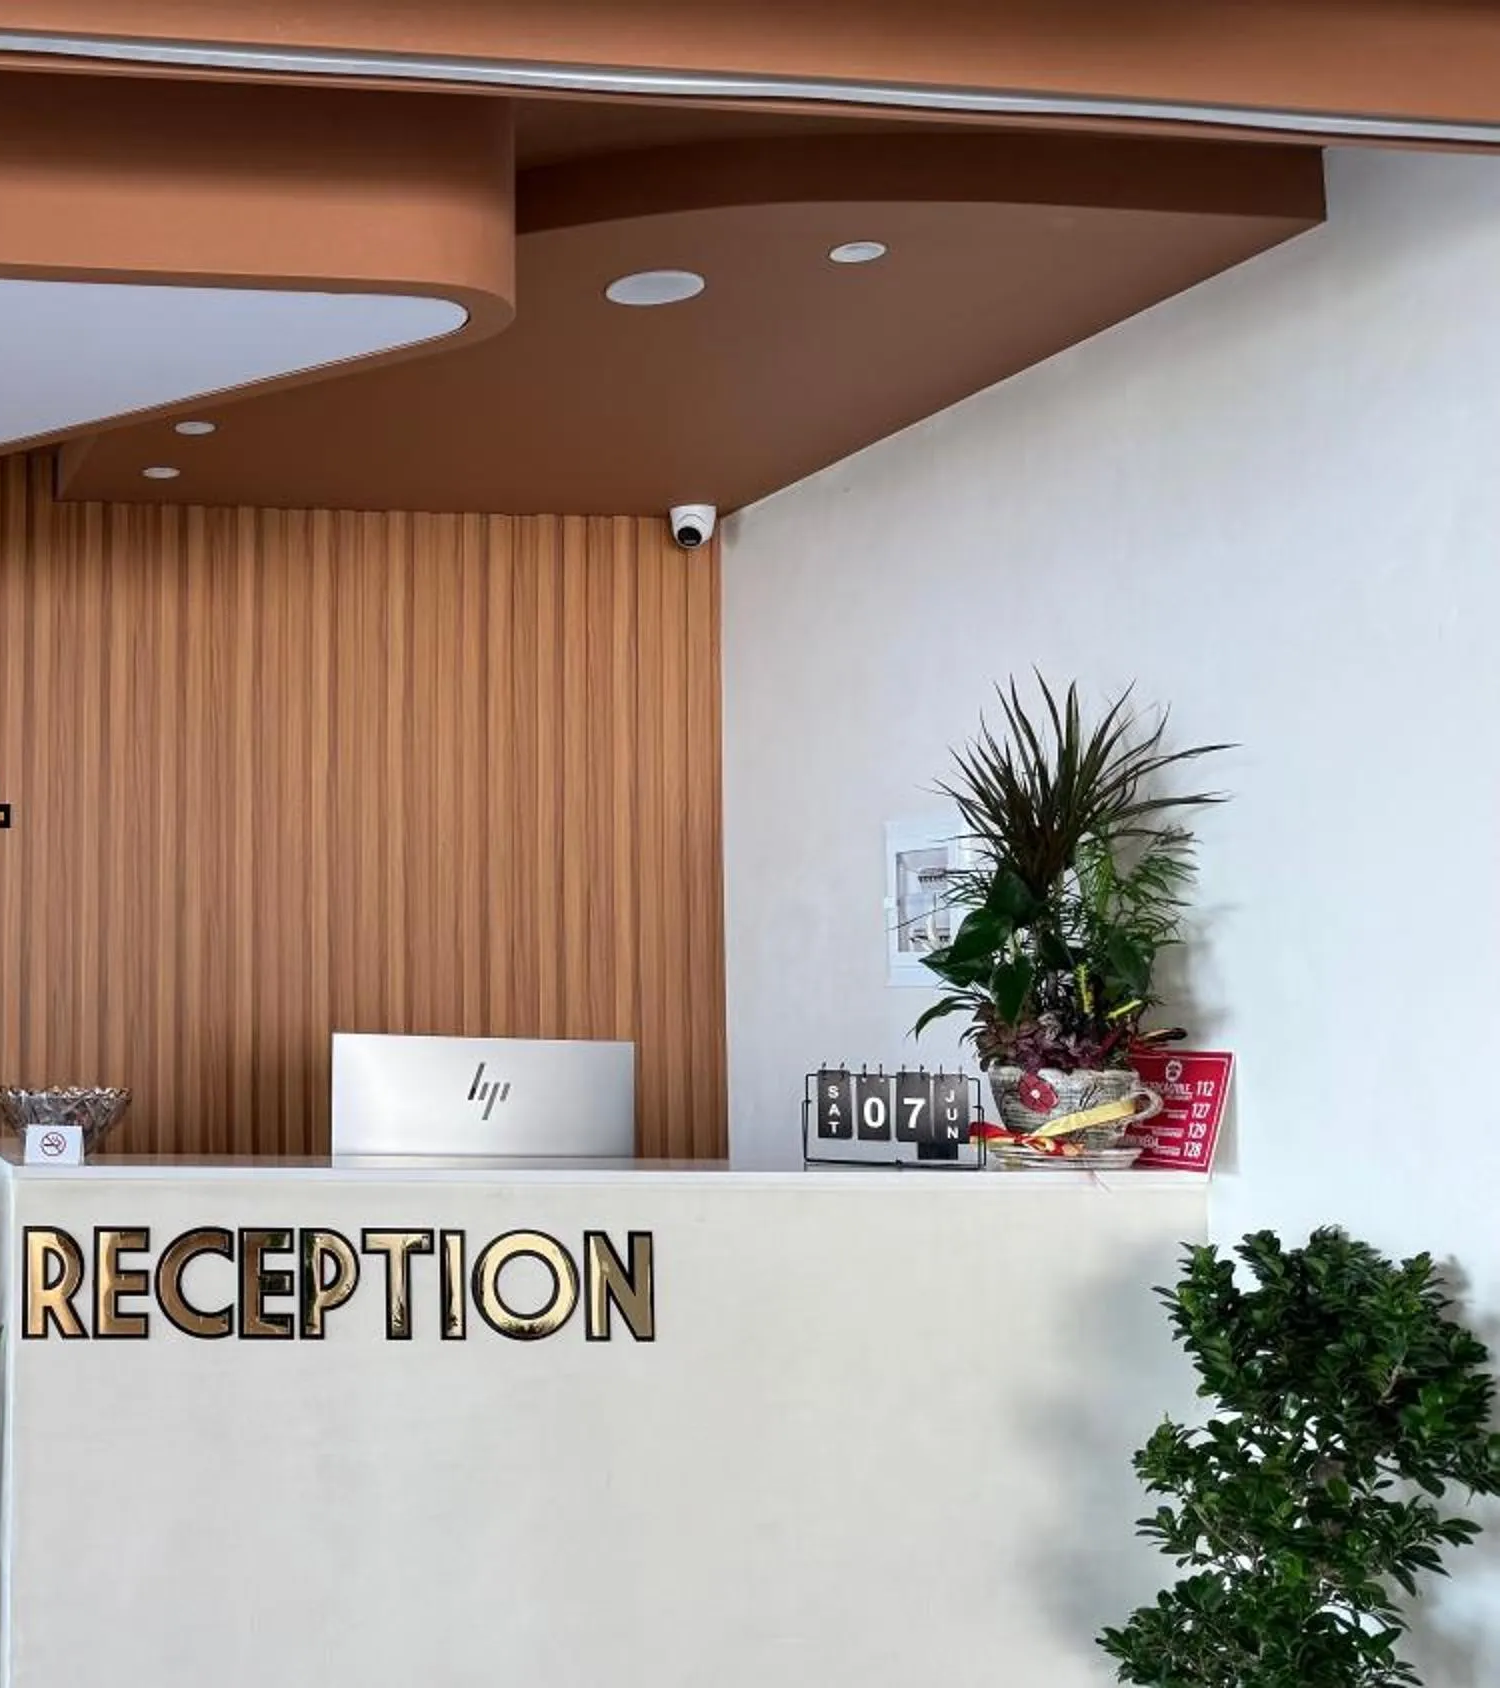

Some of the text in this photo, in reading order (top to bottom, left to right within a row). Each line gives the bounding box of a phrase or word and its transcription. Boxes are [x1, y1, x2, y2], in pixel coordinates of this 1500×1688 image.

[827, 1085, 841, 1134] SAT
[945, 1089, 959, 1139] JUN
[22, 1225, 656, 1342] RECEPTION
